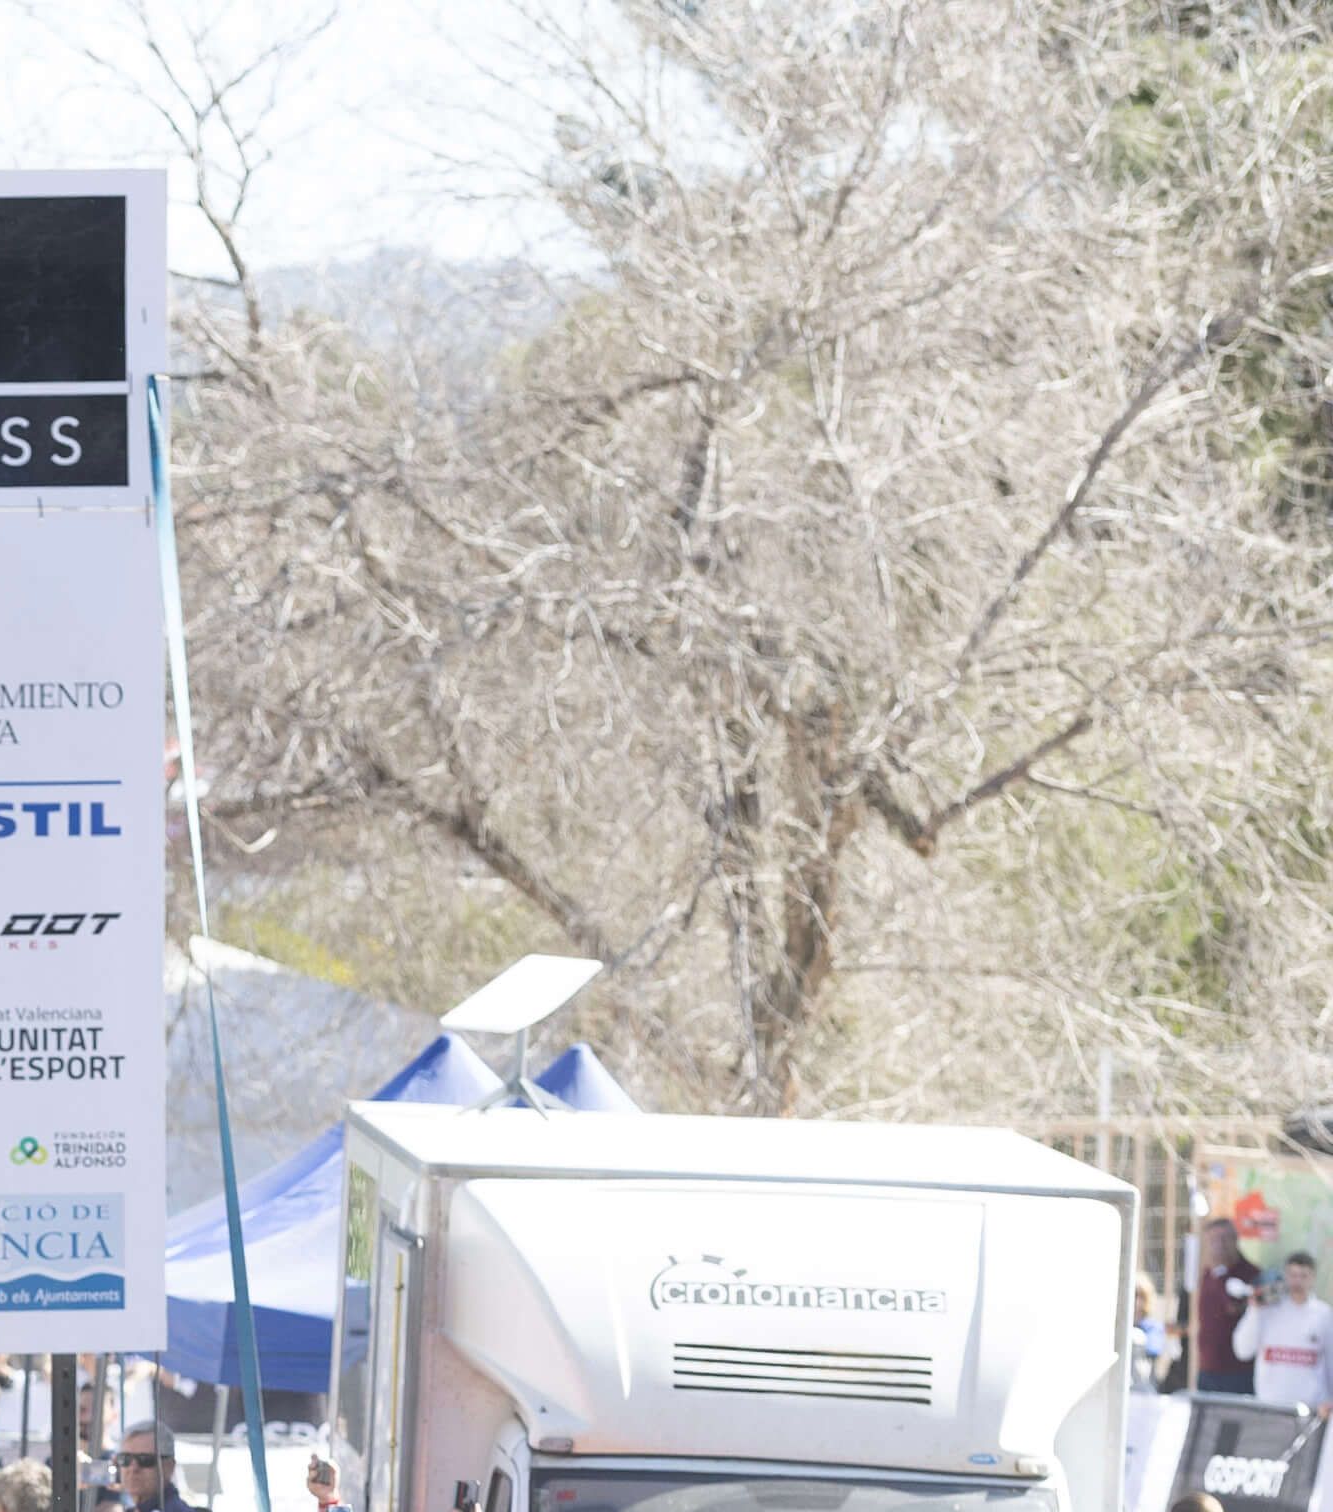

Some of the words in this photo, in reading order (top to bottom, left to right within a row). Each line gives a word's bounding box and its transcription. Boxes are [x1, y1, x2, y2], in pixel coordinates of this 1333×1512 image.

[15, 1007, 103, 1021] Valenciana
[54, 1142, 126, 1155] TRINIDAD
[54, 1155, 126, 1169] ALFONSO
[72, 1204, 110, 1220] DE
